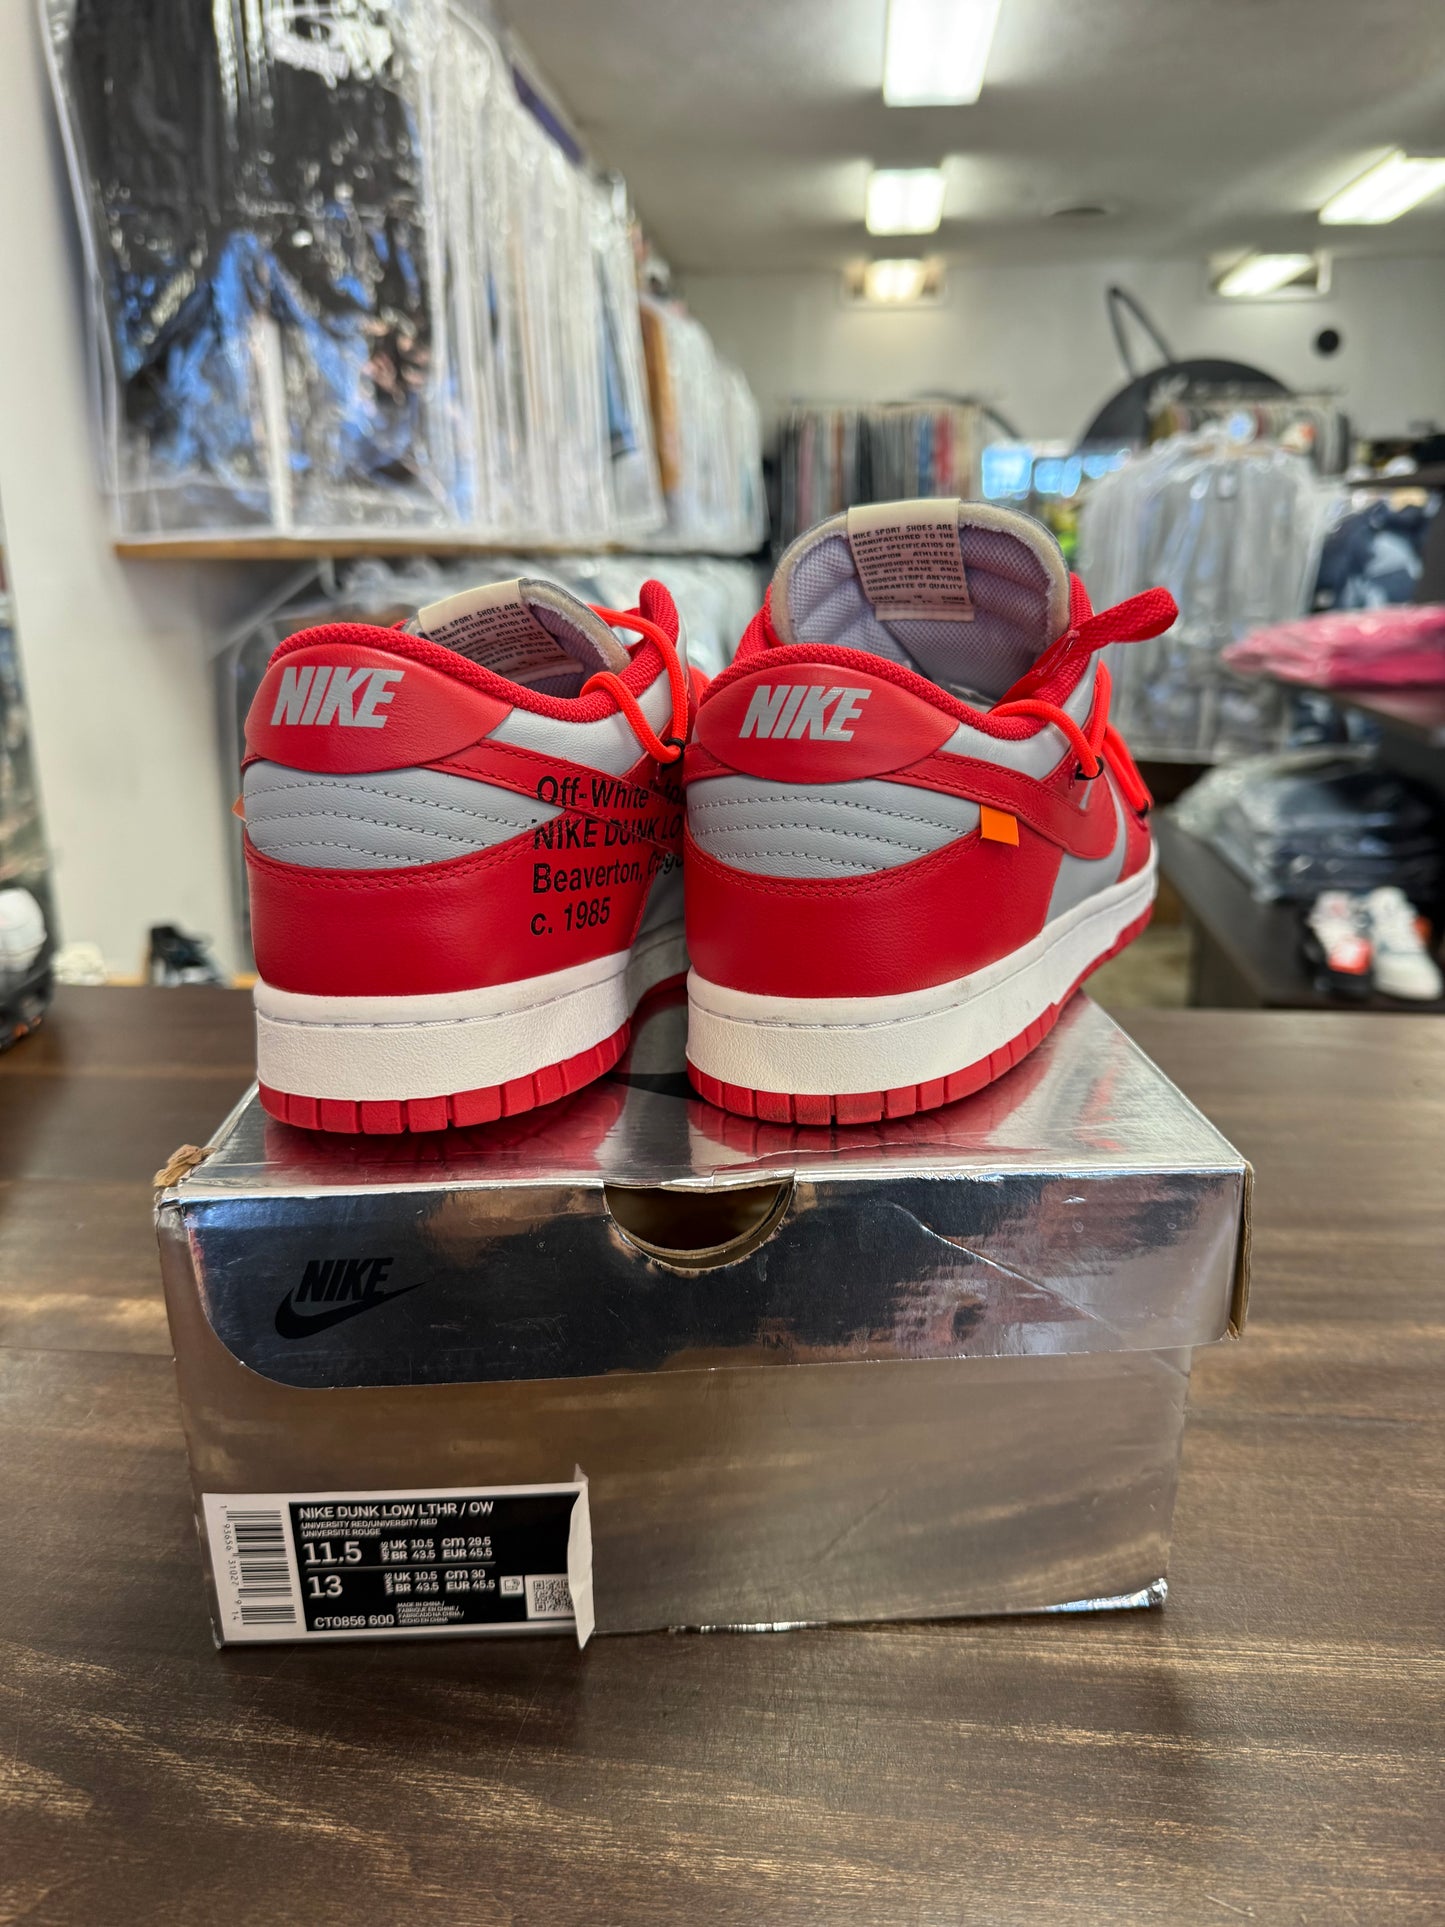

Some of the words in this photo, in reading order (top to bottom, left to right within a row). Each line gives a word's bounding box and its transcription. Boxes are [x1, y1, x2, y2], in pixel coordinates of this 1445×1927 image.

[853, 531, 871, 539] NIKE
[875, 526, 900, 535] SPORT
[906, 524, 932, 532] SHOES
[855, 534, 920, 547] MANUFACTURED
[857, 547, 882, 555] EXACT
[859, 553, 901, 563] CHAMPION
[430, 626, 447, 637] NIKE
[450, 615, 473, 627] SPORT
[477, 607, 500, 618] SHOES
[435, 618, 495, 642] MANUFACTURED
[511, 610, 525, 618] THE
[270, 666, 405, 728] NIKE
[738, 685, 872, 742] NIKE
[532, 817, 599, 850] NIKE
[605, 816, 660, 847] DUNK
[661, 813, 683, 840] LO
[533, 859, 643, 893] Beaverton,
[530, 913, 552, 935] c.
[564, 897, 611, 931] 1985
[296, 1257, 394, 1302] NIKE
[300, 1506, 334, 1519] NIKE
[337, 1506, 379, 1518] DUNK
[383, 1504, 415, 1517] LOW
[419, 1503, 457, 1515] LTHR
[469, 1501, 494, 1513] OW
[301, 1521, 349, 1529] UNIVERSITY
[351, 1519, 418, 1528] RED/UNIVERSITY
[302, 1529, 350, 1537] UNIVERSITE
[352, 1528, 381, 1536] ROUGE
[223, 1524, 233, 1551] 93656
[390, 1540, 408, 1548] UK
[411, 1539, 434, 1548] 10.5
[441, 1538, 465, 1547] cm
[468, 1537, 491, 1546] 29.5
[302, 1541, 362, 1564] 11.5
[392, 1551, 408, 1560] BR
[412, 1550, 436, 1559] 43.5
[443, 1549, 467, 1558] EUR
[469, 1548, 492, 1557] 45.5
[393, 1572, 412, 1581] UK
[414, 1571, 437, 1581] 10.5
[445, 1570, 469, 1579] cm
[471, 1569, 486, 1579] 30
[308, 1575, 343, 1598] 13
[395, 1583, 412, 1592] BR
[416, 1582, 439, 1591] 43.5
[446, 1581, 470, 1590] EUR
[472, 1579, 495, 1589] 45.5
[314, 1615, 366, 1628] CT0856
[368, 1614, 395, 1625] 600
